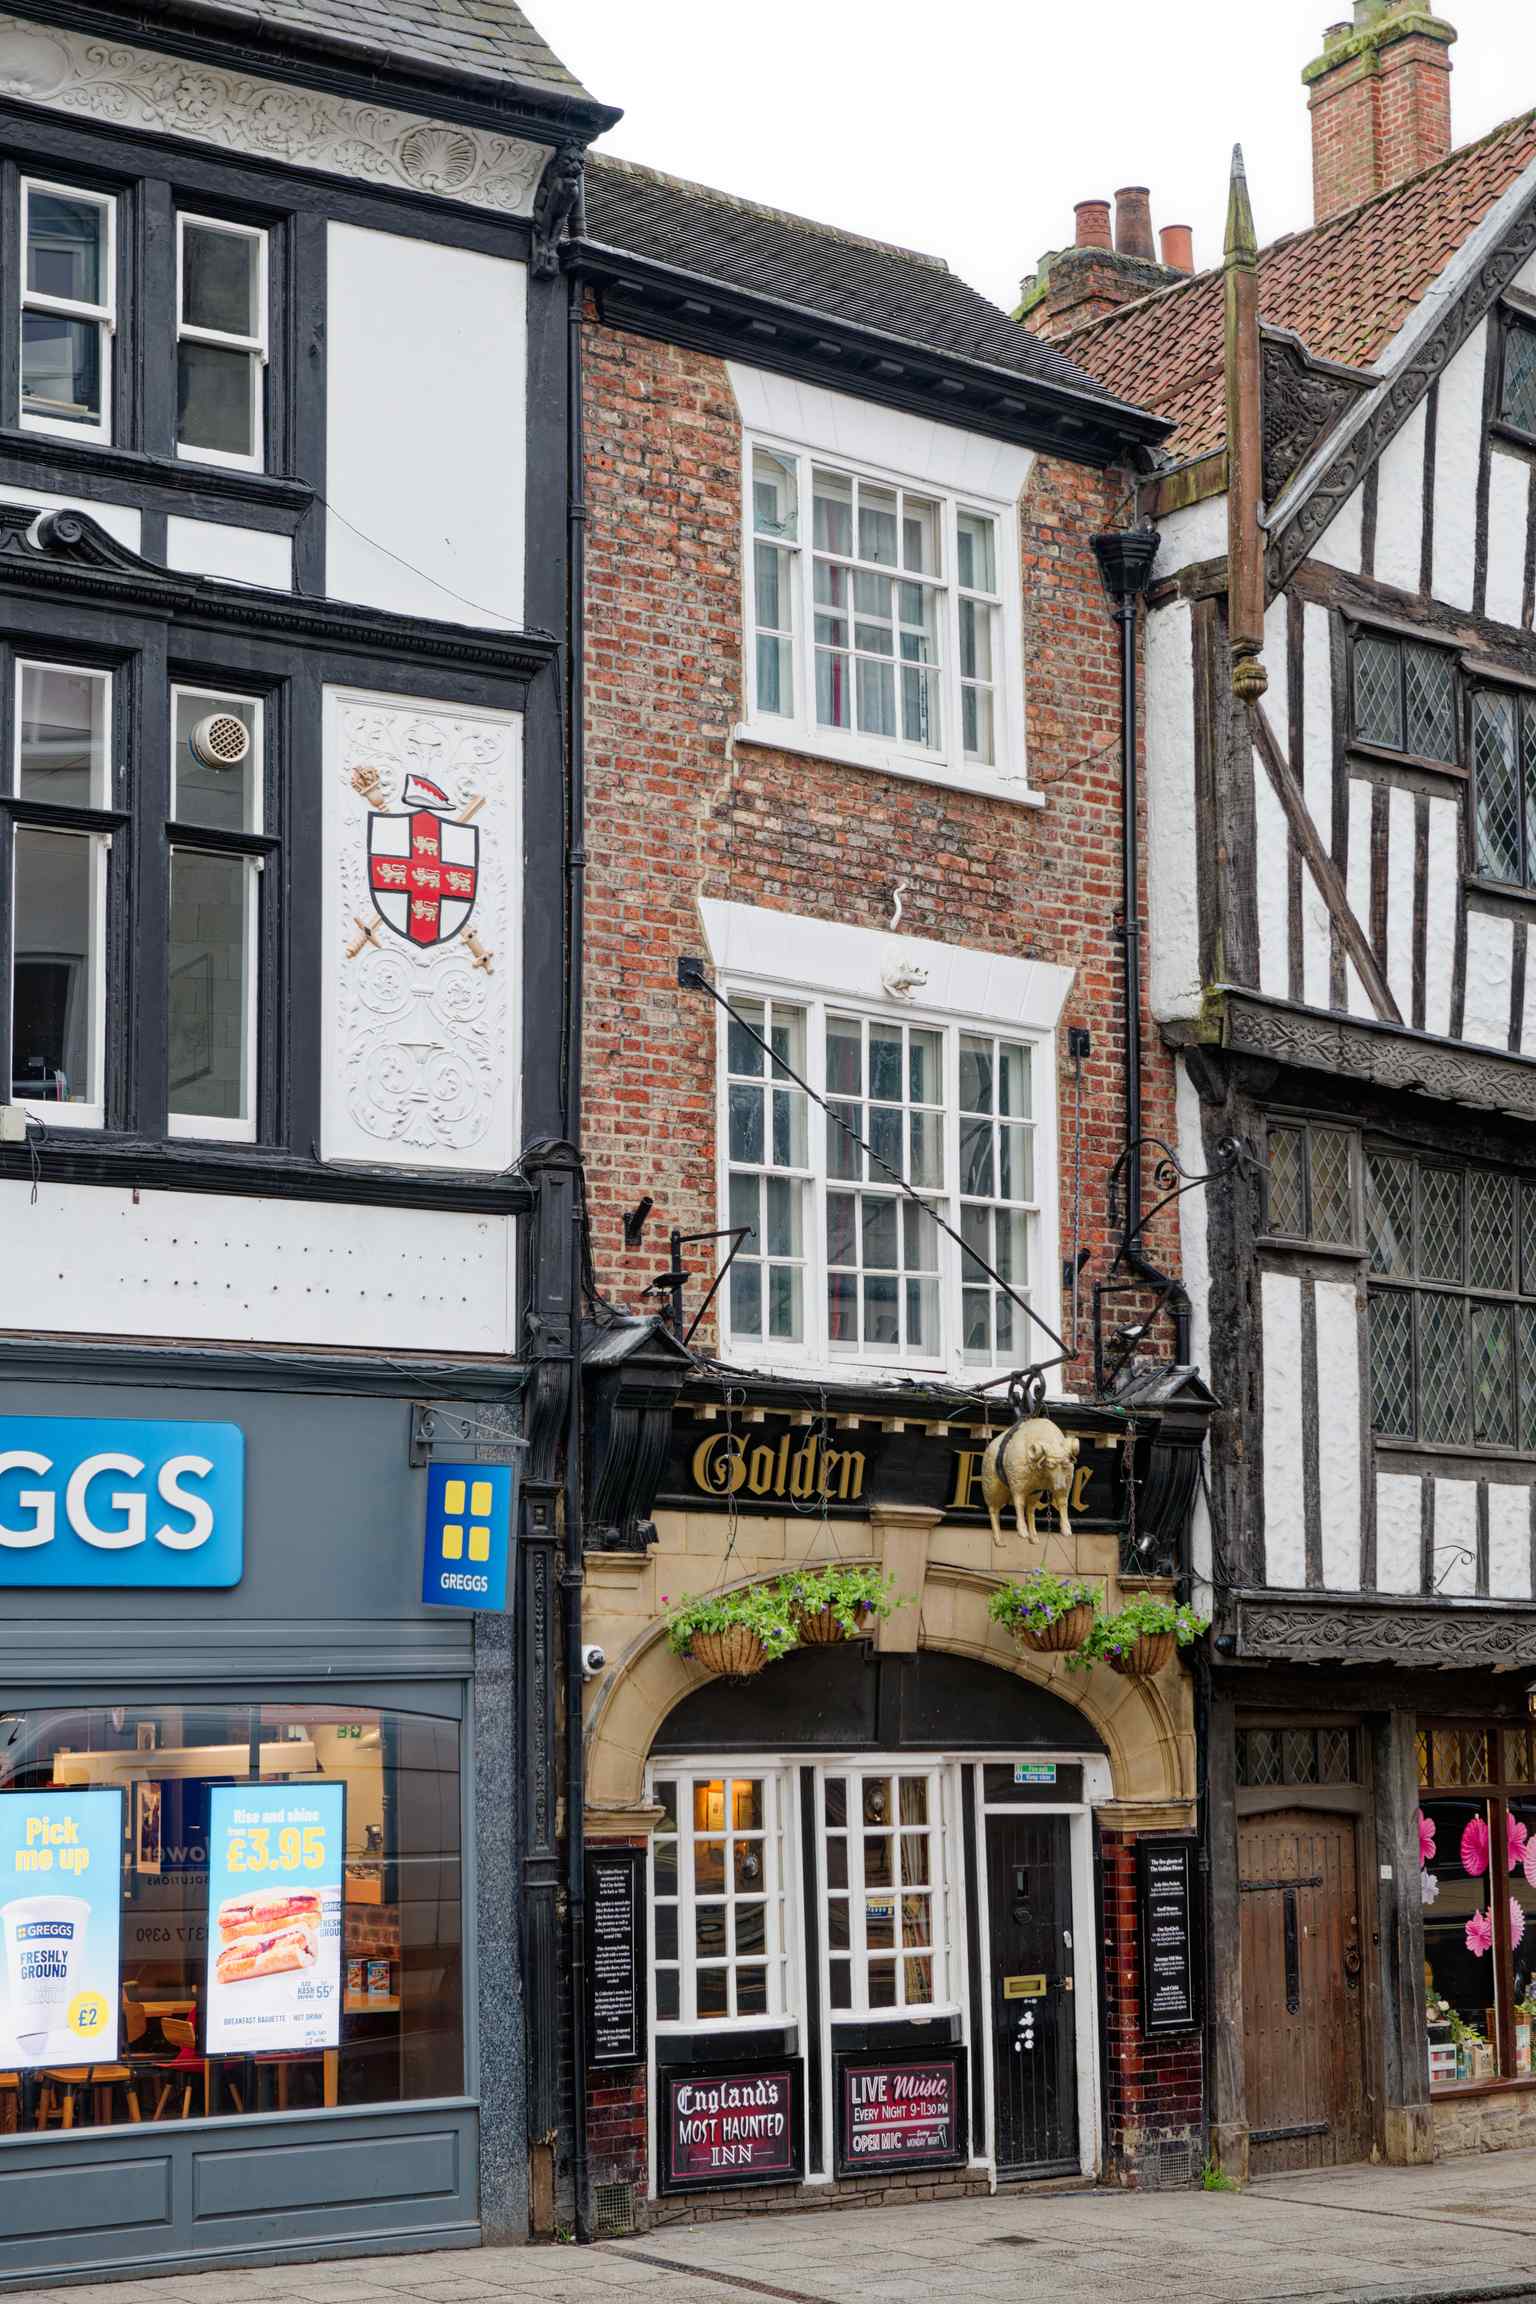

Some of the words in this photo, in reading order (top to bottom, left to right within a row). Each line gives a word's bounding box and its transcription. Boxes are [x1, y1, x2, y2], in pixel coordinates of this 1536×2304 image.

[692, 1432, 866, 1500] Golden
[441, 1572, 488, 1592] GREGGS
[233, 1808, 260, 1824] Rise
[261, 1808, 285, 1823] and
[287, 1807, 320, 1822] shine
[25, 1816, 80, 1846] Pick
[227, 1826, 326, 1873] £3.95
[16, 1850, 53, 1872] me
[59, 1848, 90, 1876] up
[27, 1923, 72, 1937] GREGGS
[20, 1949, 69, 1966] FRESHLY
[21, 1964, 67, 1980] GROUND
[78, 2008, 97, 2027] £2
[677, 2079, 779, 2115] England's
[851, 2075, 888, 2104] LIVE
[893, 2074, 947, 2100] Music
[937, 2103, 948, 2114] PM
[679, 2118, 719, 2145] MOST
[723, 2112, 784, 2141] HAUNTED
[852, 2134, 880, 2152] OPEN
[881, 2132, 902, 2150] MIC
[906, 2137, 926, 2147] MONDAY
[711, 2144, 753, 2166] INN
